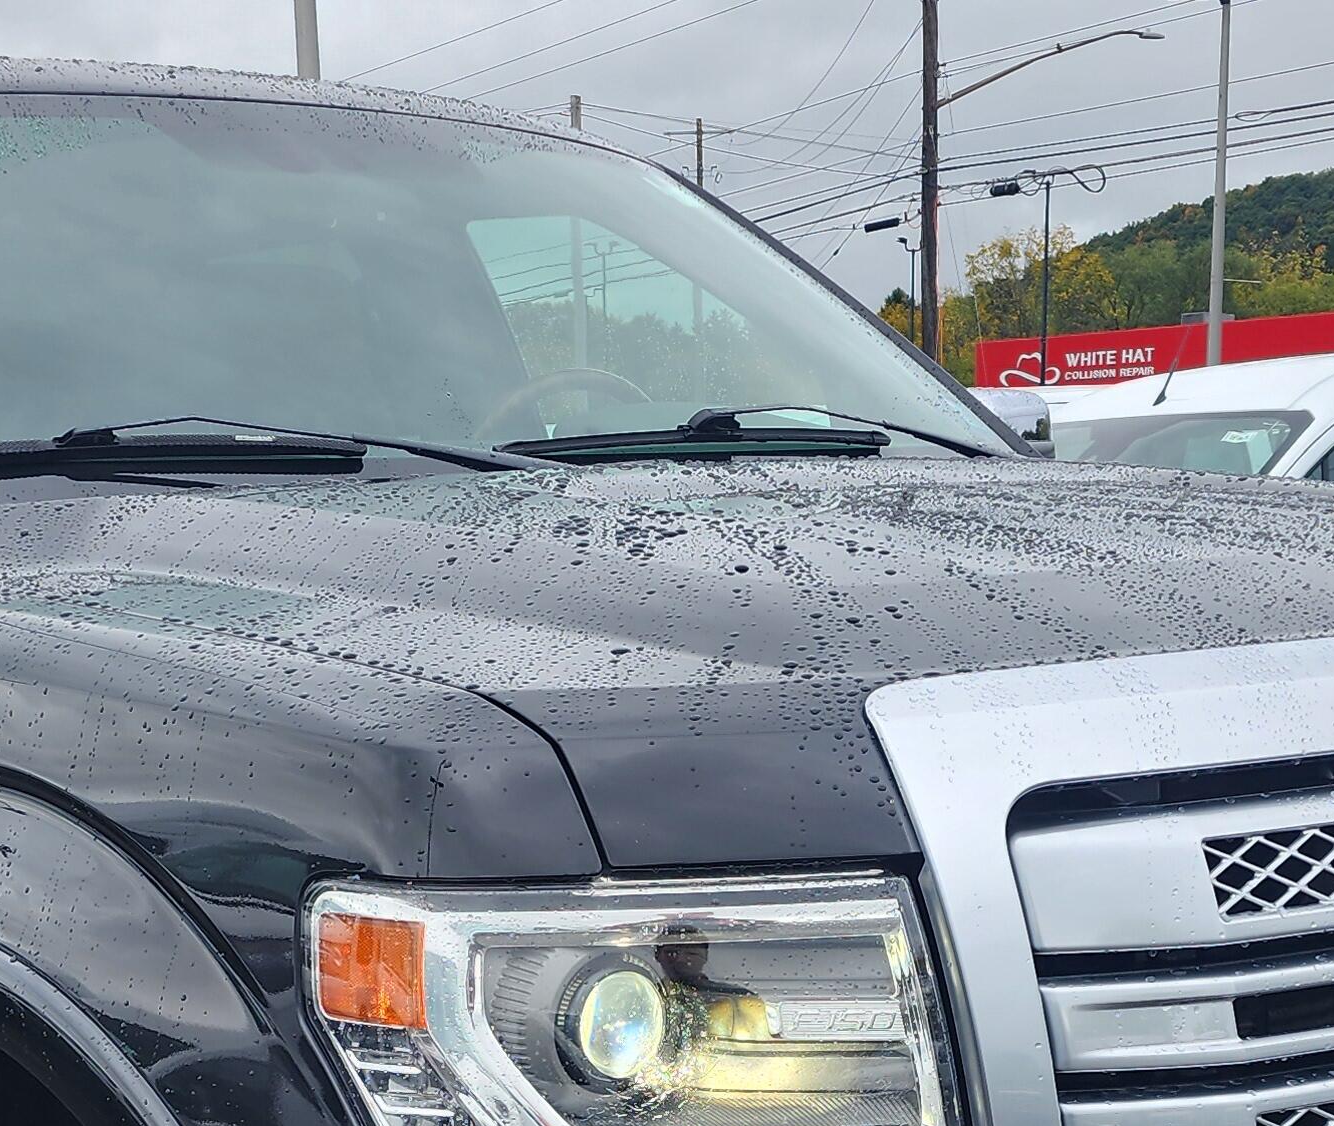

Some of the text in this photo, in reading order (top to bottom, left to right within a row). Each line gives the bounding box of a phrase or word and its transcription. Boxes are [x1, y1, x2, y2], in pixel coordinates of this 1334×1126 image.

[1065, 347, 1155, 368] WHITE HAT
[1064, 366, 1155, 381] COLLISION REPAIR
